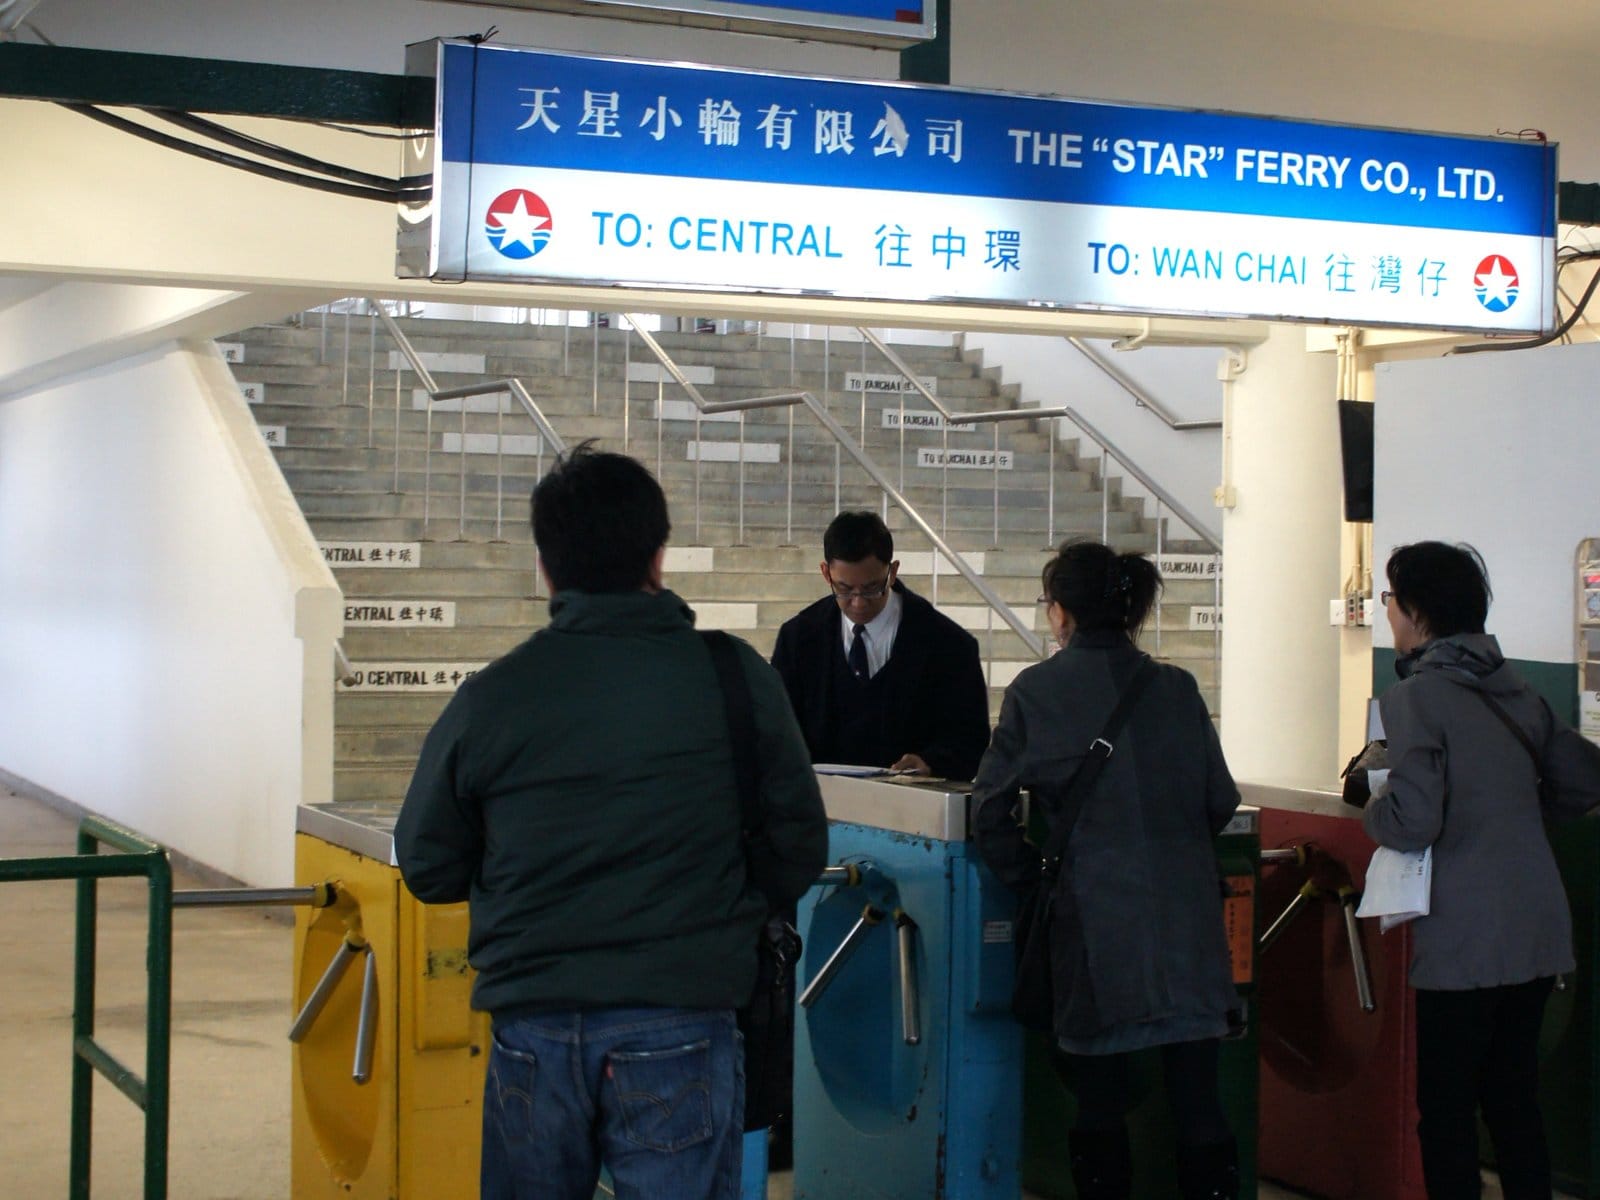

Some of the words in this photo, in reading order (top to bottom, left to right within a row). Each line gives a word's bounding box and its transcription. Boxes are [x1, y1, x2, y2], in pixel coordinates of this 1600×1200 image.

[516, 86, 963, 163] 天星小輪有限公司
[1007, 128, 1083, 169] THE
[1235, 148, 1351, 189] FERRY
[1359, 160, 1426, 202] CO.,
[1437, 165, 1505, 202] LTD.
[592, 210, 653, 249] TO:
[668, 216, 843, 258] CENTRAL
[874, 223, 1021, 271] 往中環
[1087, 241, 1140, 276] TO:
[1152, 246, 1222, 280] WAN
[1234, 250, 1306, 286] CHAI
[1324, 252, 1448, 297] 往灣仔
[850, 378, 861, 389] TO
[888, 414, 898, 425] TO
[923, 453, 935, 464] TO
[344, 606, 395, 621] ENTRAL
[1196, 612, 1209, 625] TO
[367, 670, 429, 686] CENTRAL
